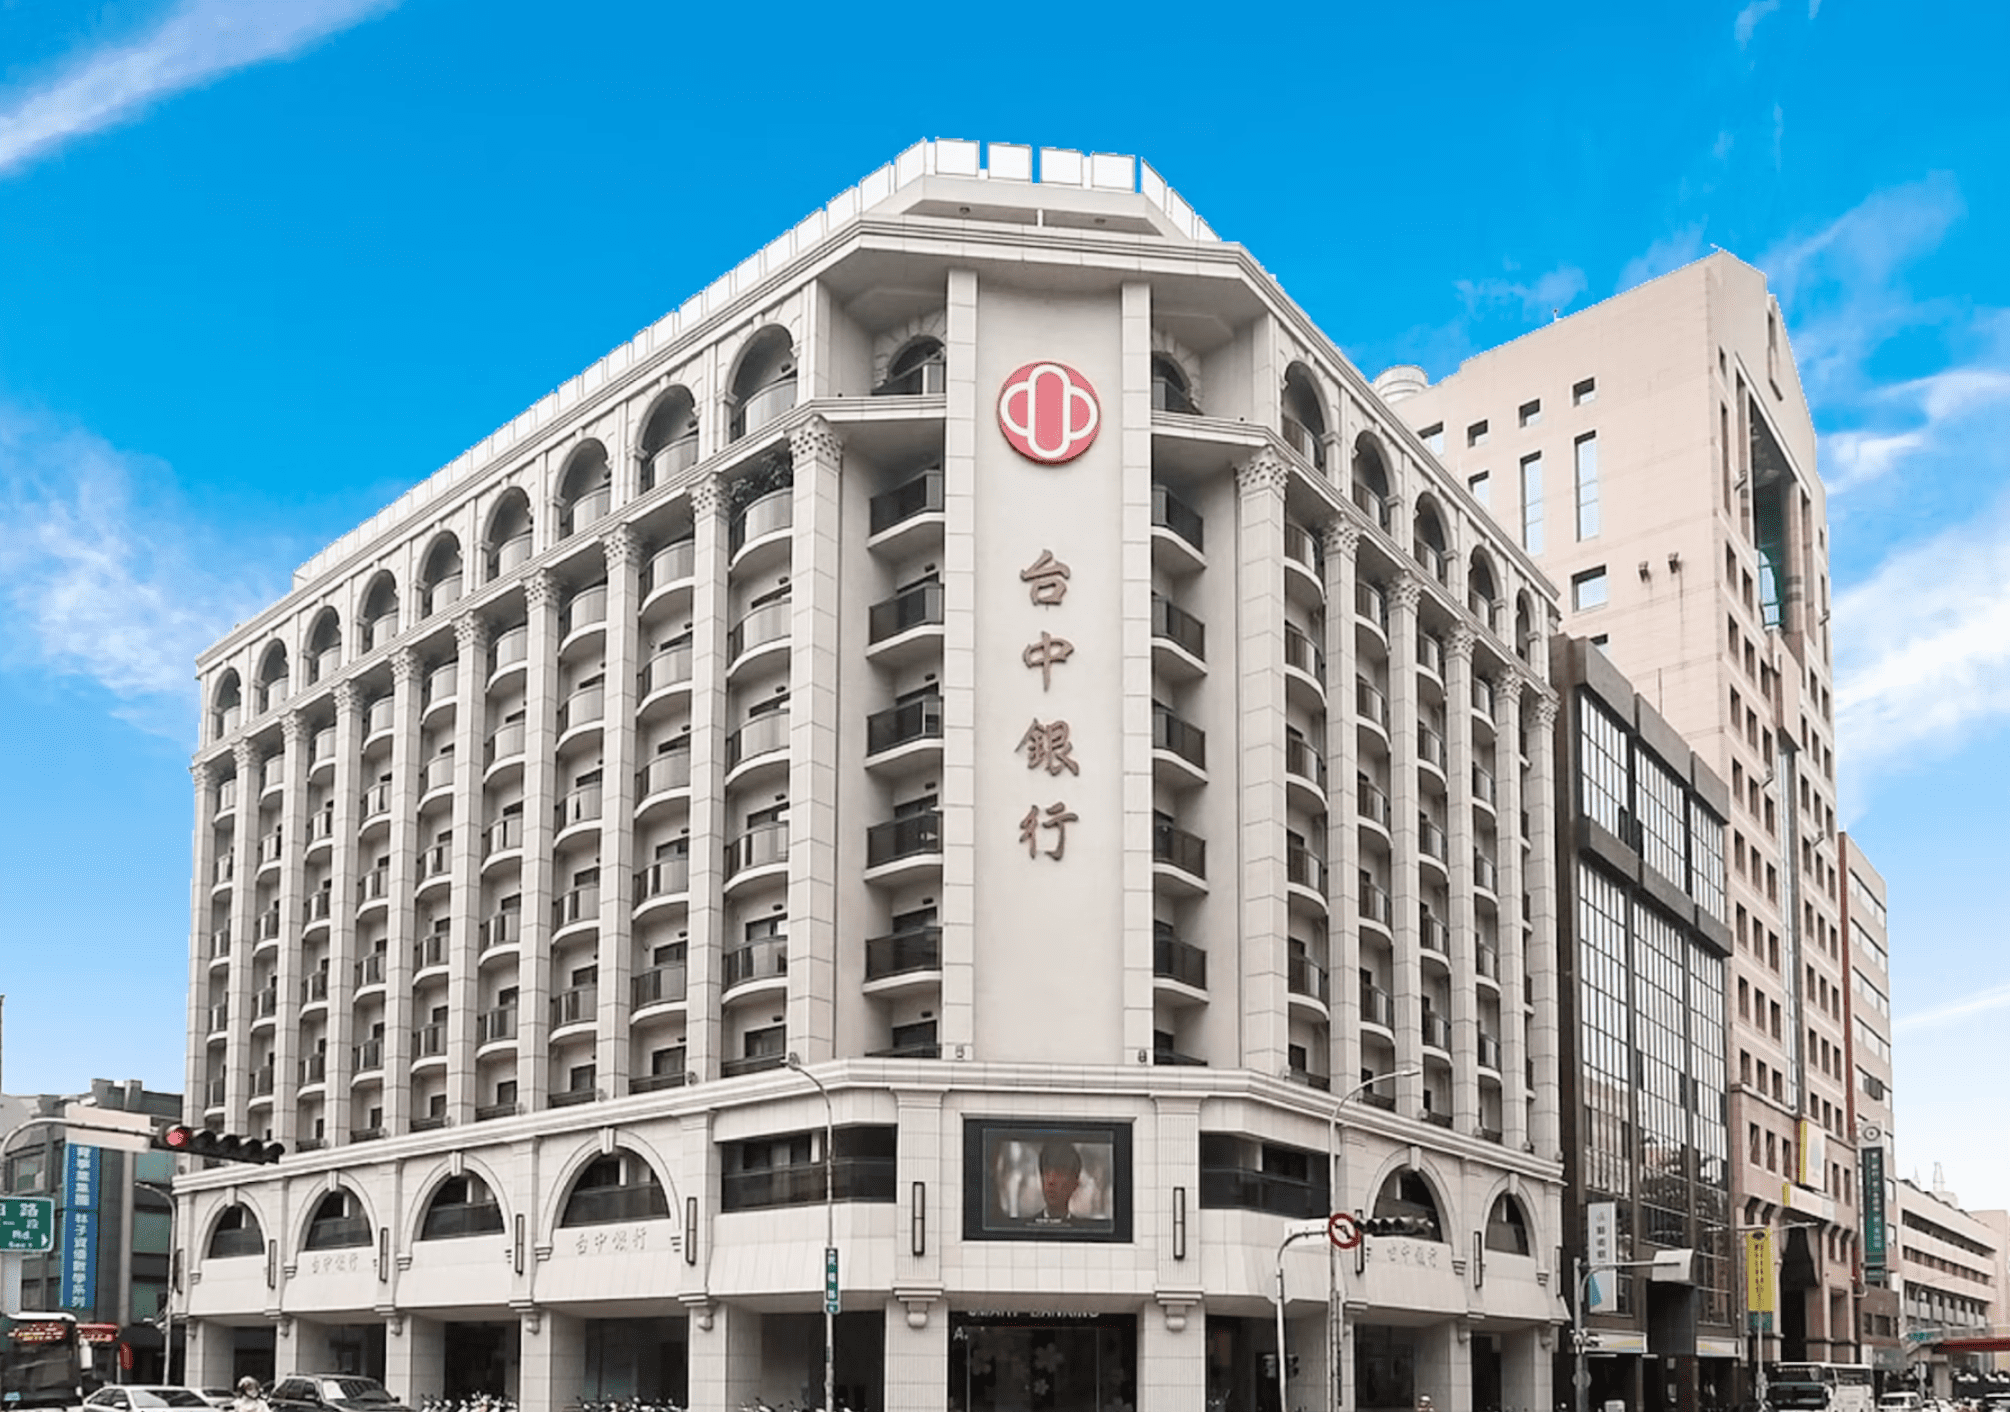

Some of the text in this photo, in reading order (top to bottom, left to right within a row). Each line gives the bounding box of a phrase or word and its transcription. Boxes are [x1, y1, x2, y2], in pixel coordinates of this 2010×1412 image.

[1014, 549, 1080, 862] 台中銀行
[575, 1227, 647, 1255] 台中銀行
